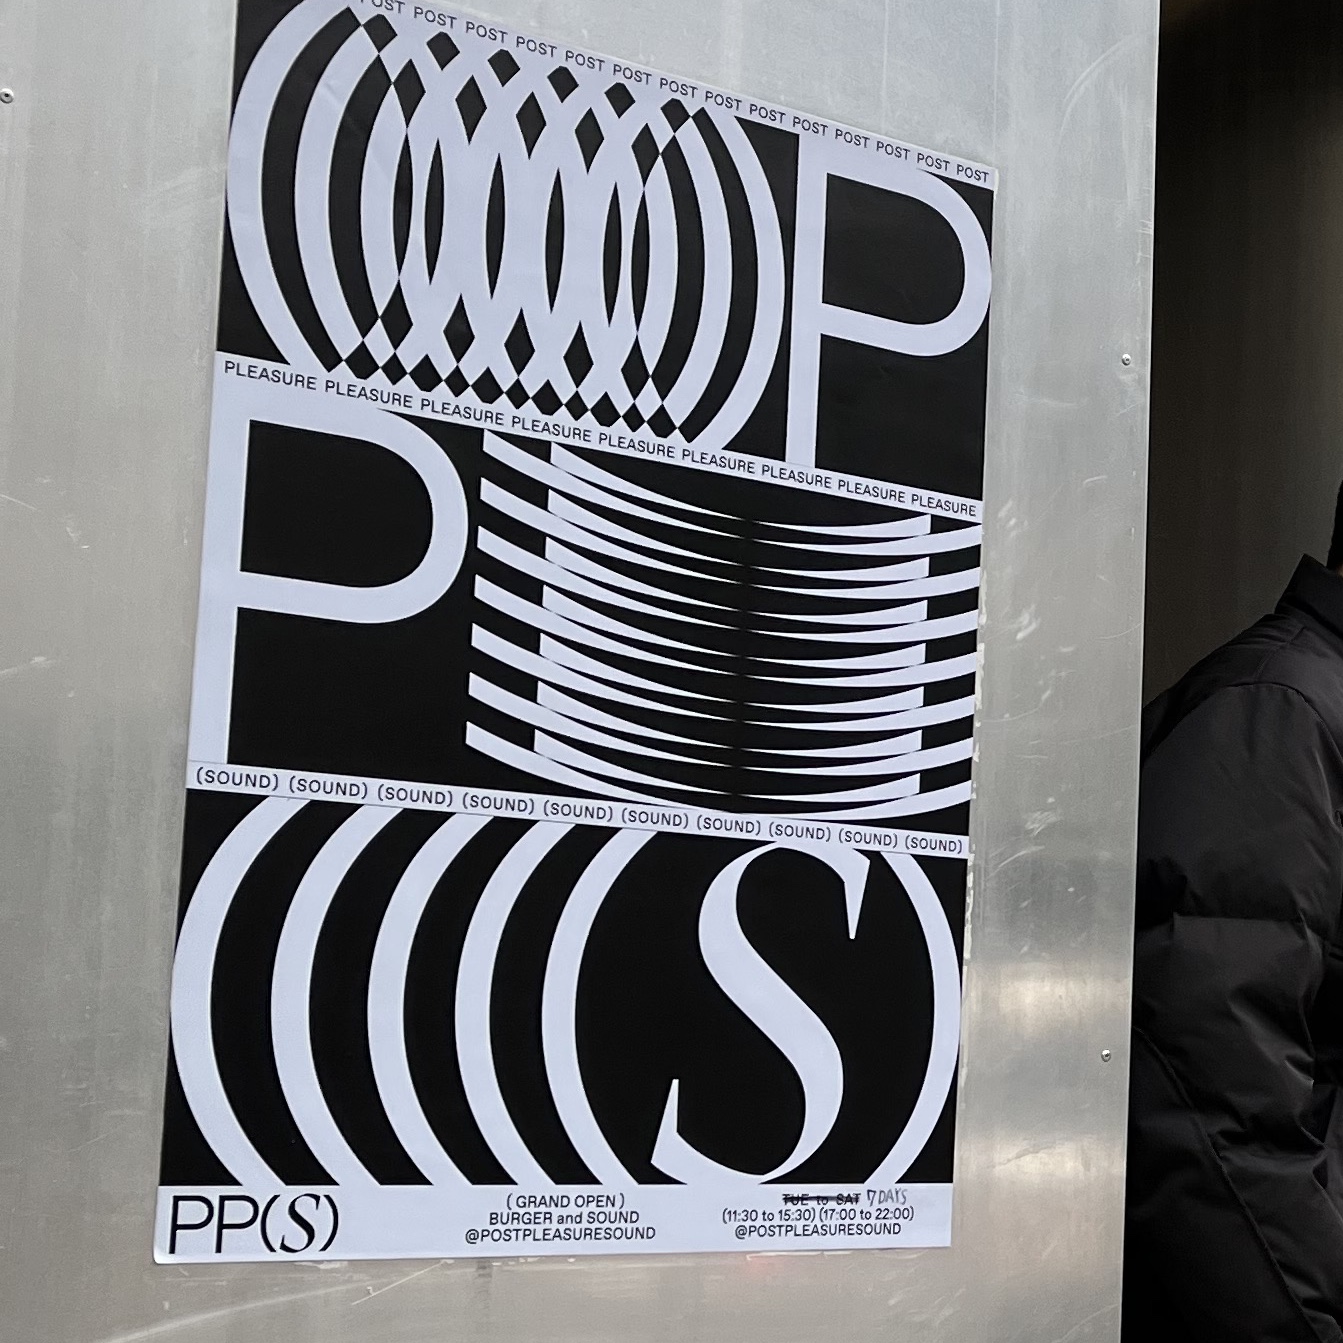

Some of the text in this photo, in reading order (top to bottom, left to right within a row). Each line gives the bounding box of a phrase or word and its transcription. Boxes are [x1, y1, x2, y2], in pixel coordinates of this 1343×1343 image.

[361, 0, 990, 184] OST POST POST POST POST POST POST POST POST POST POST POST POST POST
[785, 133, 992, 468] P
[224, 360, 977, 517] PLEASURE PLEASURE PLEASURE PLEASURE PLEASURE PLEASURE PLEASURE PLEASURE PLEASURE
[188, 395, 469, 763] P
[196, 766, 963, 855] (SOUND) (SOUND) (SOUND) (SOUND) (SOUND) (SOUND) (SOUND) (SOUND) (SOUND) (SOUND)
[168, 1193, 339, 1255] PP(S)
[465, 1226, 656, 1245] @POSTPLEASURESOUND
[489, 1210, 640, 1226] BURGER and SOUND
[722, 1206, 915, 1224] (11:30 to 15:30) (17:00 to 22:00)
[735, 1222, 902, 1240] @POSTPLEASURESOUND
